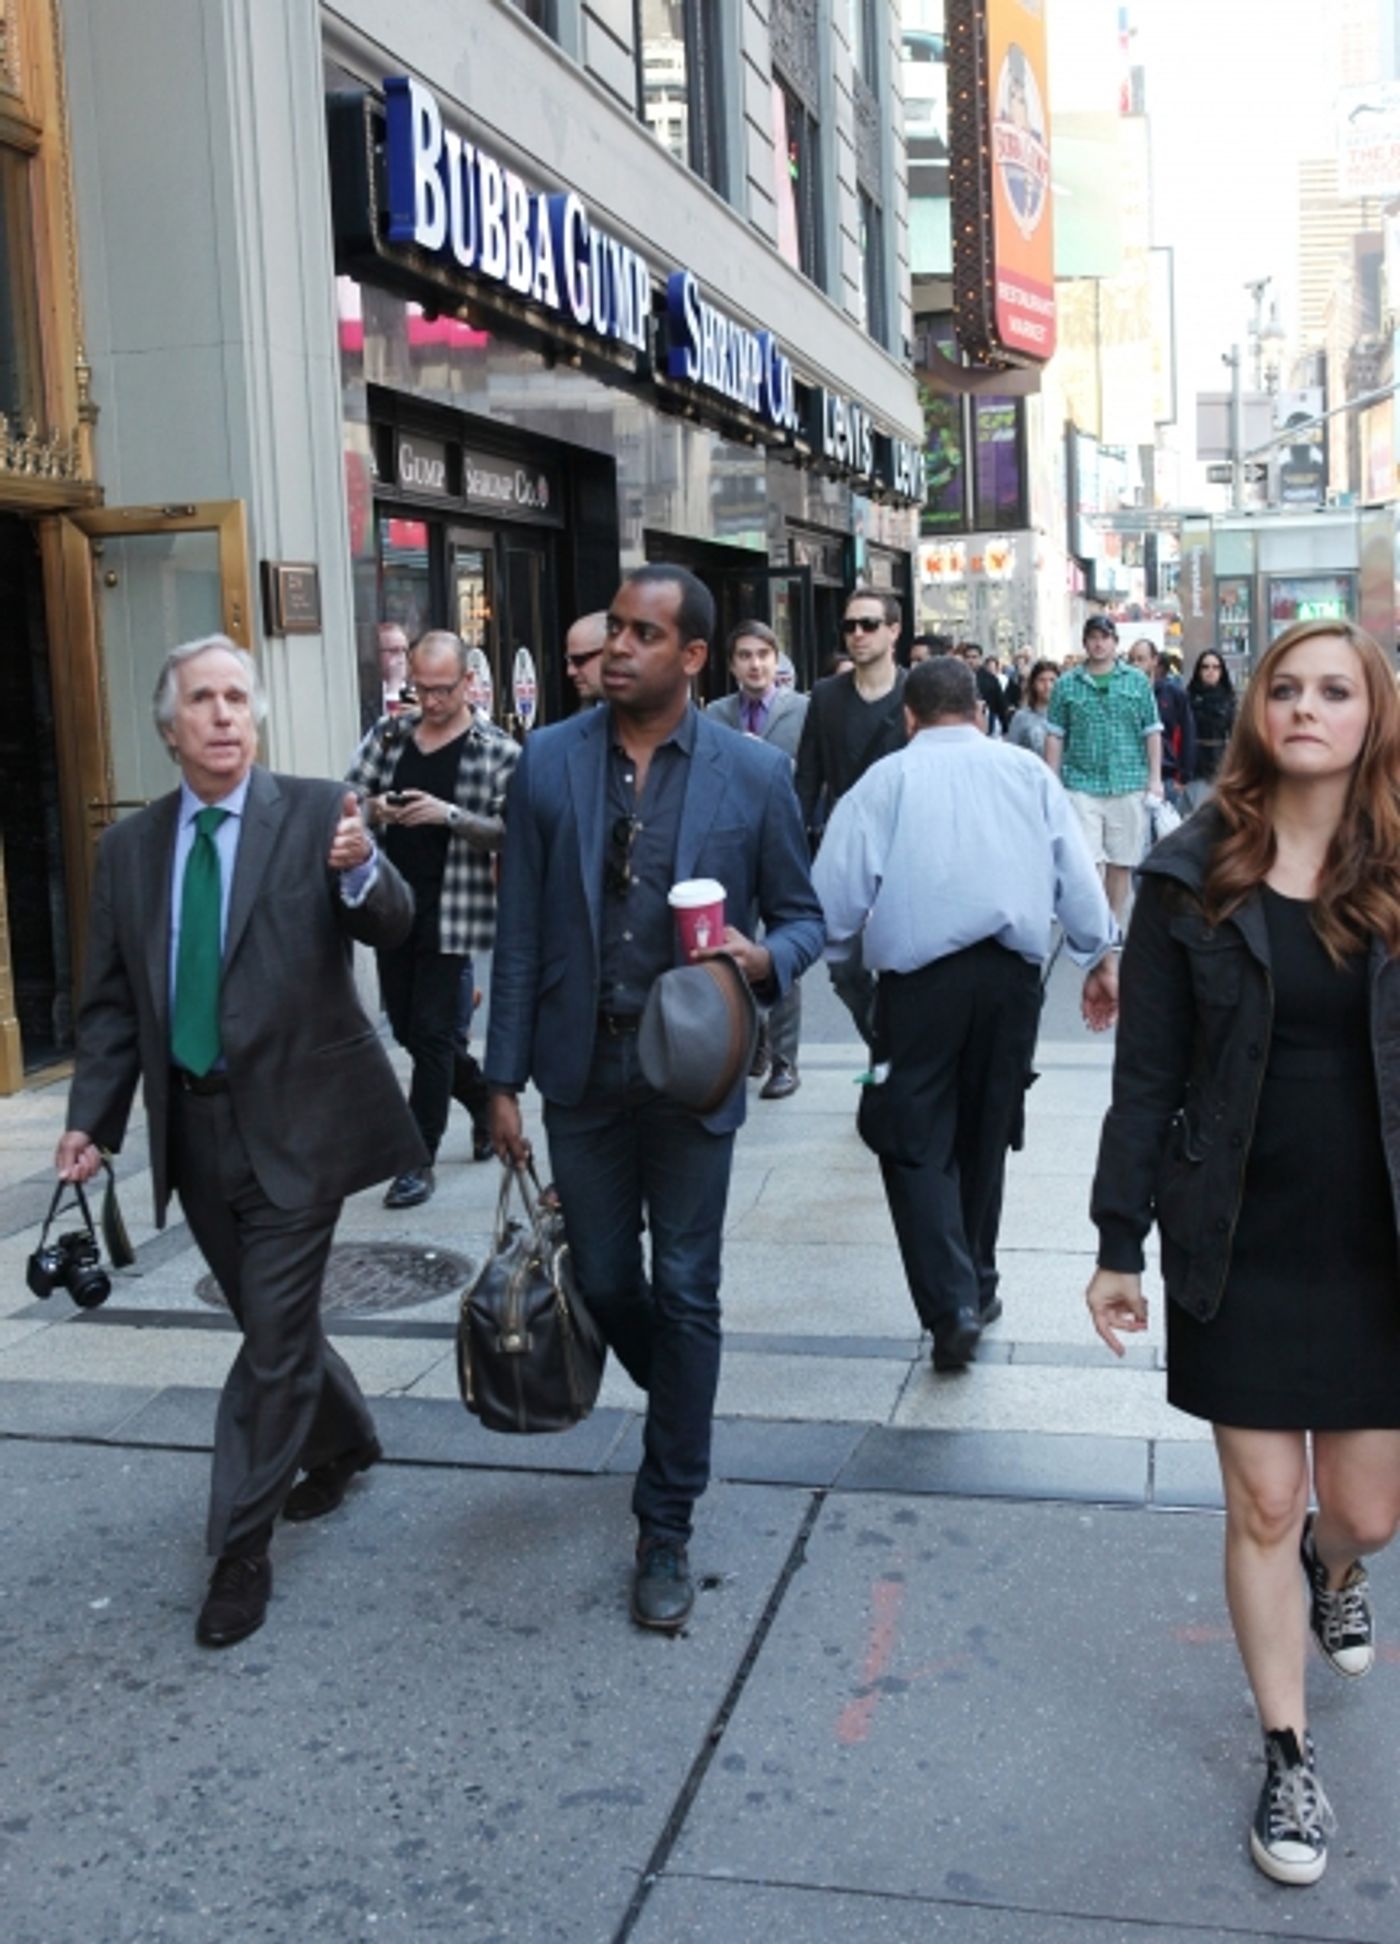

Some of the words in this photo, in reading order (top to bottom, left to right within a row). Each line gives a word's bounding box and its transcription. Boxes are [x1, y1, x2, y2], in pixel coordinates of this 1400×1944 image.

[405, 77, 560, 312] BUBBA
[563, 191, 652, 354] GUMP
[683, 272, 762, 413] SHRIMP
[399, 443, 446, 488] GUMP
[1299, 600, 1341, 620] ATM
